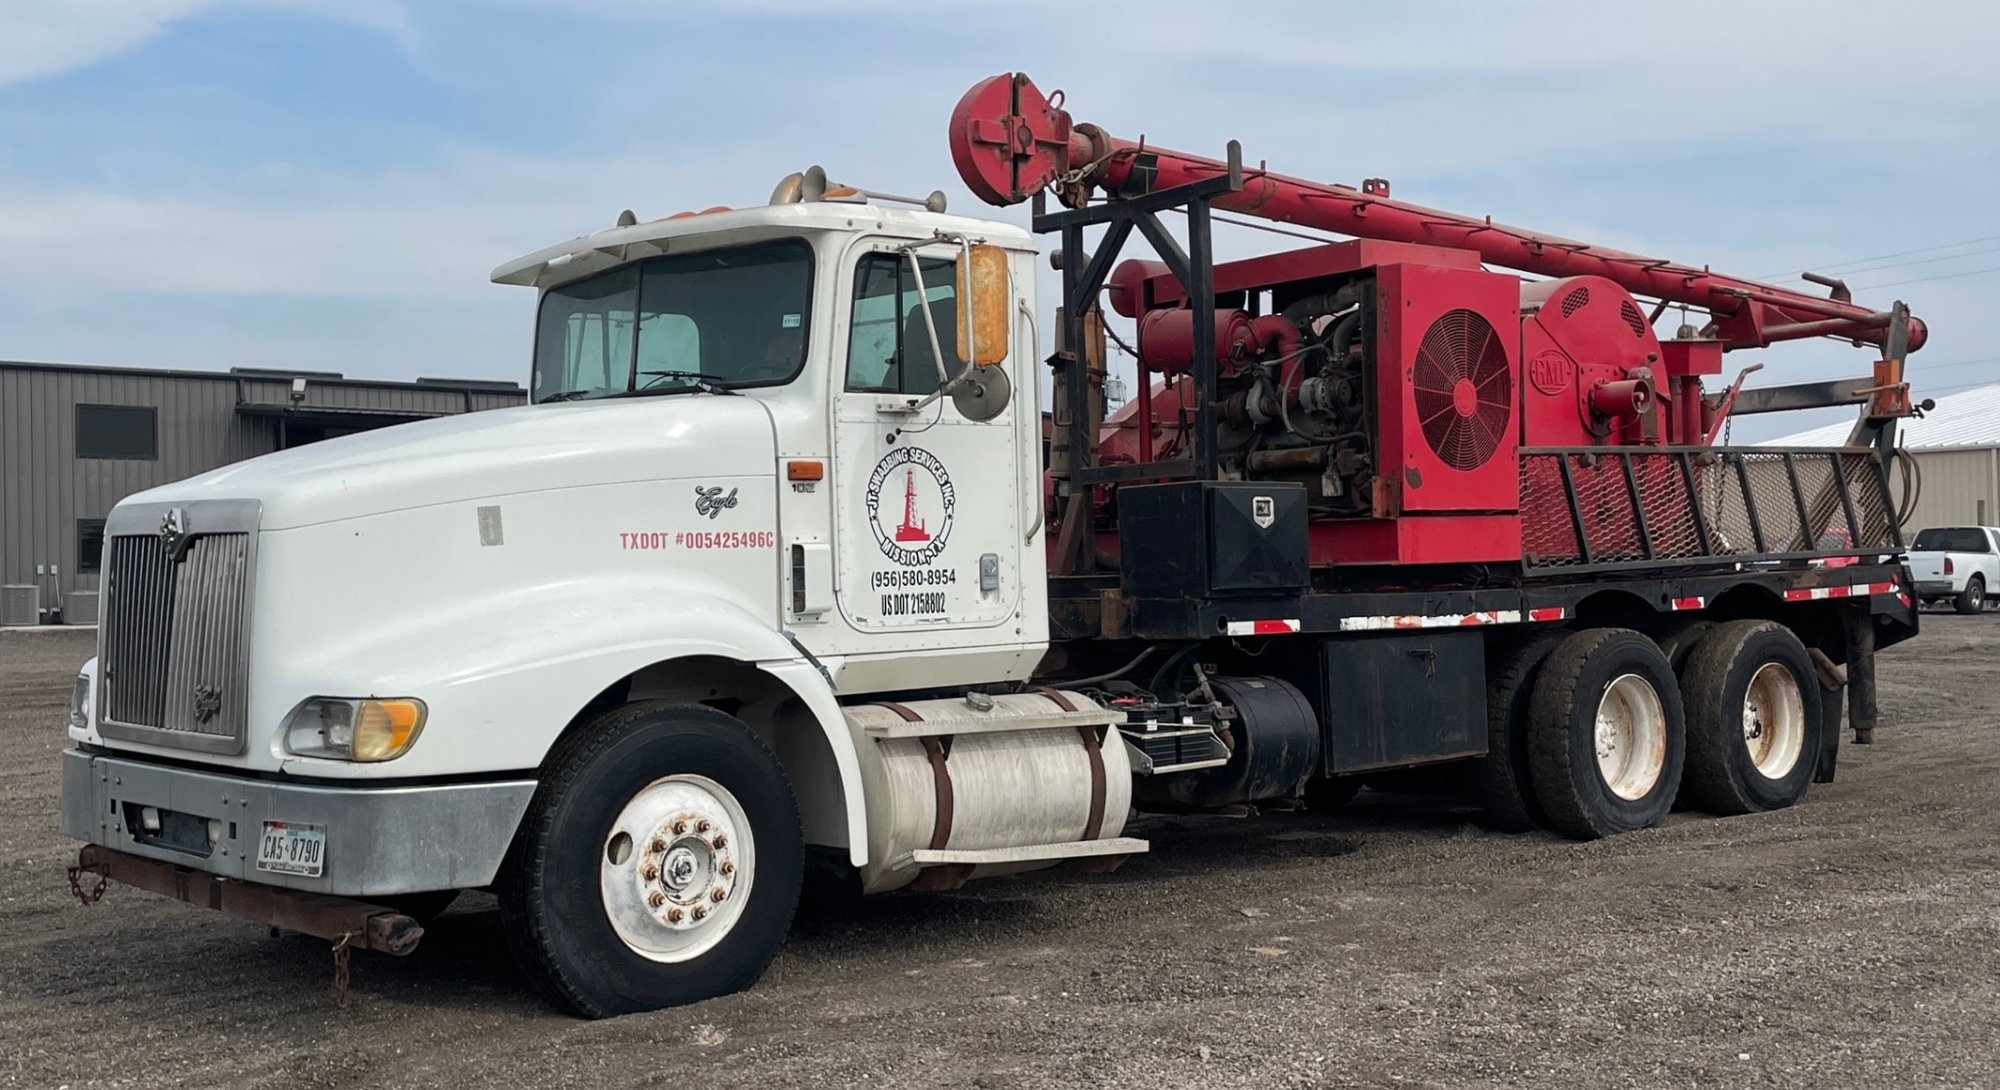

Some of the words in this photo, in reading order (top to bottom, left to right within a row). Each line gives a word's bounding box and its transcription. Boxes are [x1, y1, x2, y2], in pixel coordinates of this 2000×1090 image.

[868, 447, 909, 494] SWABBING
[909, 447, 949, 486] SERVICES
[792, 483, 816, 493] 102
[941, 481, 955, 509] INC.
[695, 485, 738, 520] Eagle
[866, 491, 879, 510] JT
[620, 532, 669, 550] TXDOT
[675, 531, 774, 549] #005425496C
[871, 568, 956, 592] (956)580-8954
[881, 594, 893, 616] US
[893, 593, 909, 615] DOT
[910, 592, 946, 614] 2158802
